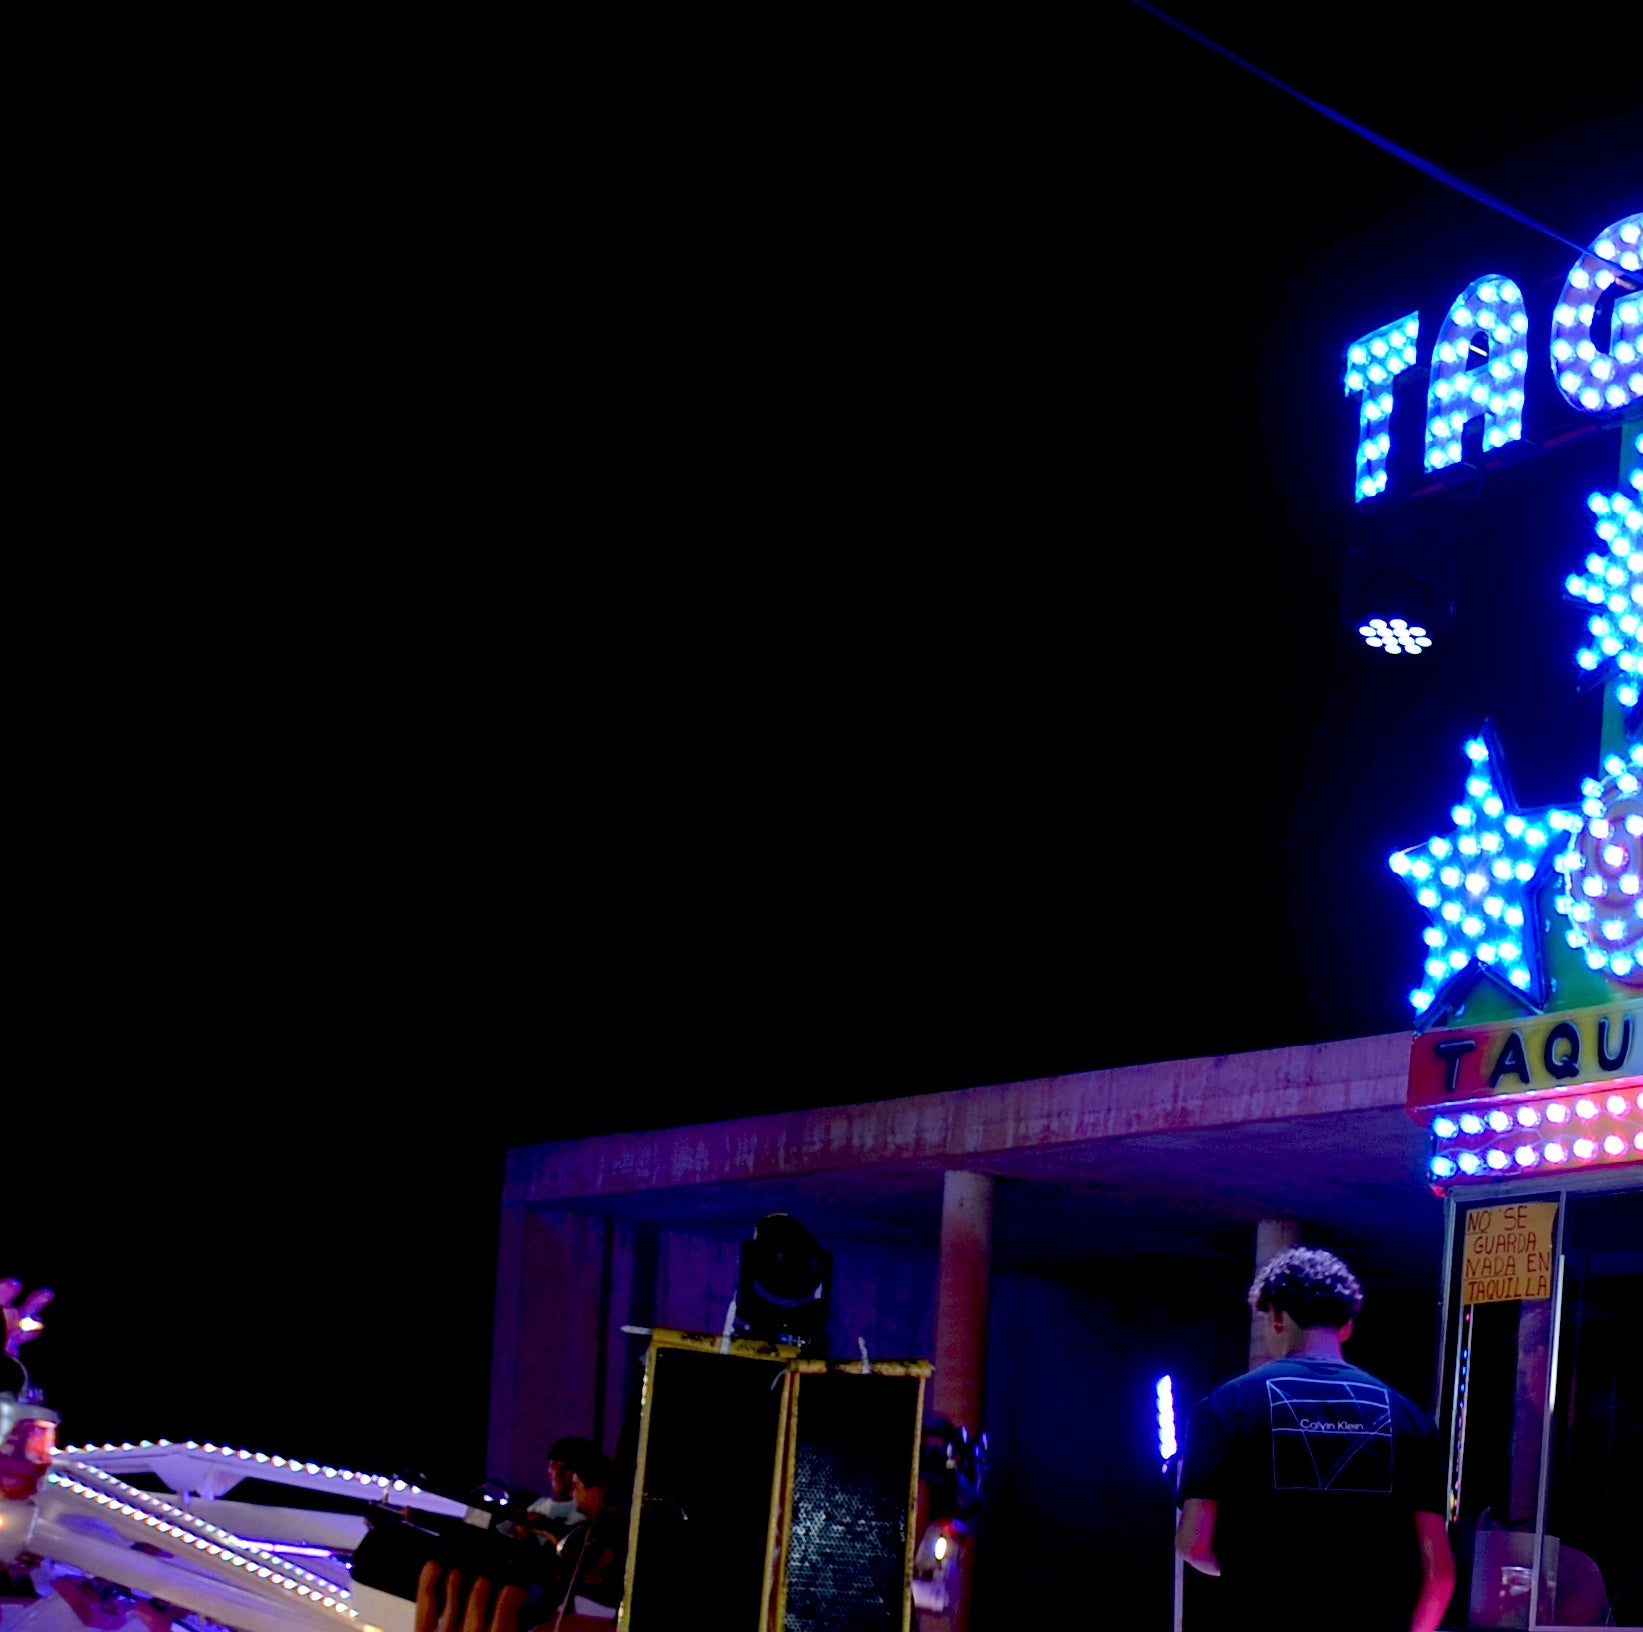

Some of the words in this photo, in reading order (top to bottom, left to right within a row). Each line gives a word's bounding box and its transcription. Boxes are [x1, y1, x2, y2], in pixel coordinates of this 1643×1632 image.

[1467, 1211, 1491, 1233] NO
[1504, 1206, 1527, 1231] SE
[1474, 1232, 1536, 1254] GUARDA
[1466, 1255, 1515, 1278] NADA
[1527, 1251, 1550, 1273] EN
[1467, 1275, 1547, 1302] TAQUILLA
[1299, 1418, 1336, 1431] Calvin
[1337, 1420, 1364, 1431] Klein
